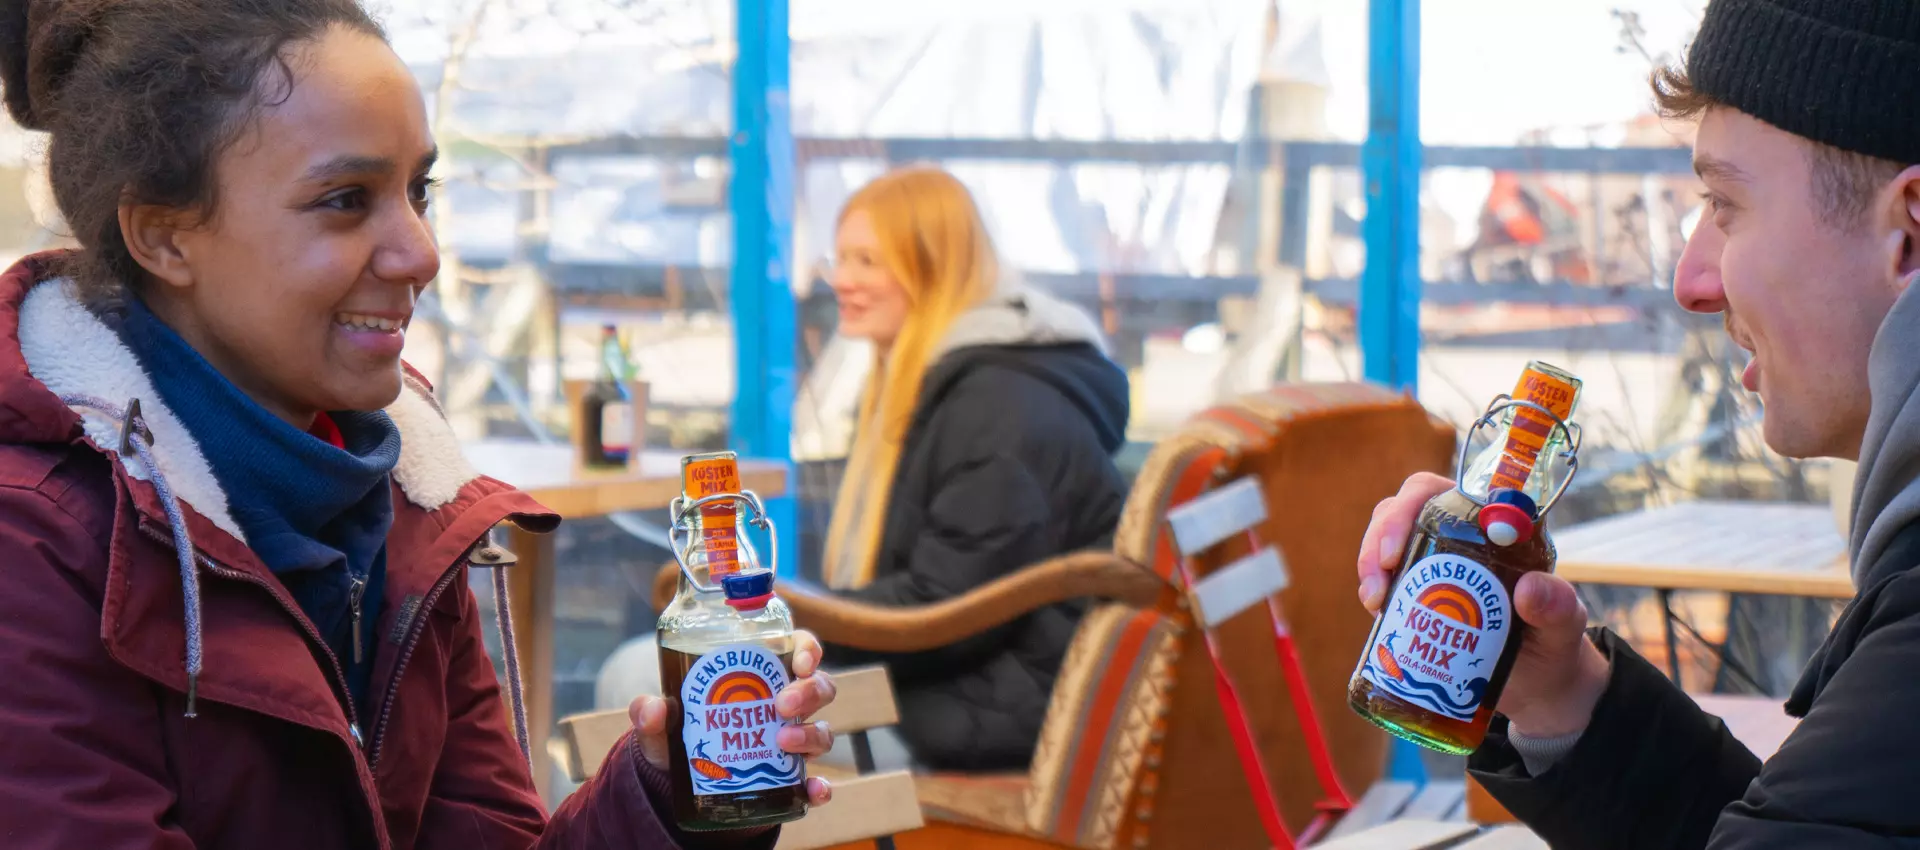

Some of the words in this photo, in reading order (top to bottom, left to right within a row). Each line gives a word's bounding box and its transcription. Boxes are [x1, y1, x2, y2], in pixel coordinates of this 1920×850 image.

[691, 464, 733, 483] KÜSTEN
[701, 480, 729, 494] MIX
[1404, 562, 1503, 632] FLENSBURGER
[1404, 607, 1480, 655] KÜSTEN
[1408, 634, 1458, 671] MIX
[1398, 654, 1454, 685] COLA-ORANGE
[705, 703, 777, 732] KÜSTEN
[721, 728, 767, 751] MIX
[716, 749, 773, 764] COLA-ORANGE
